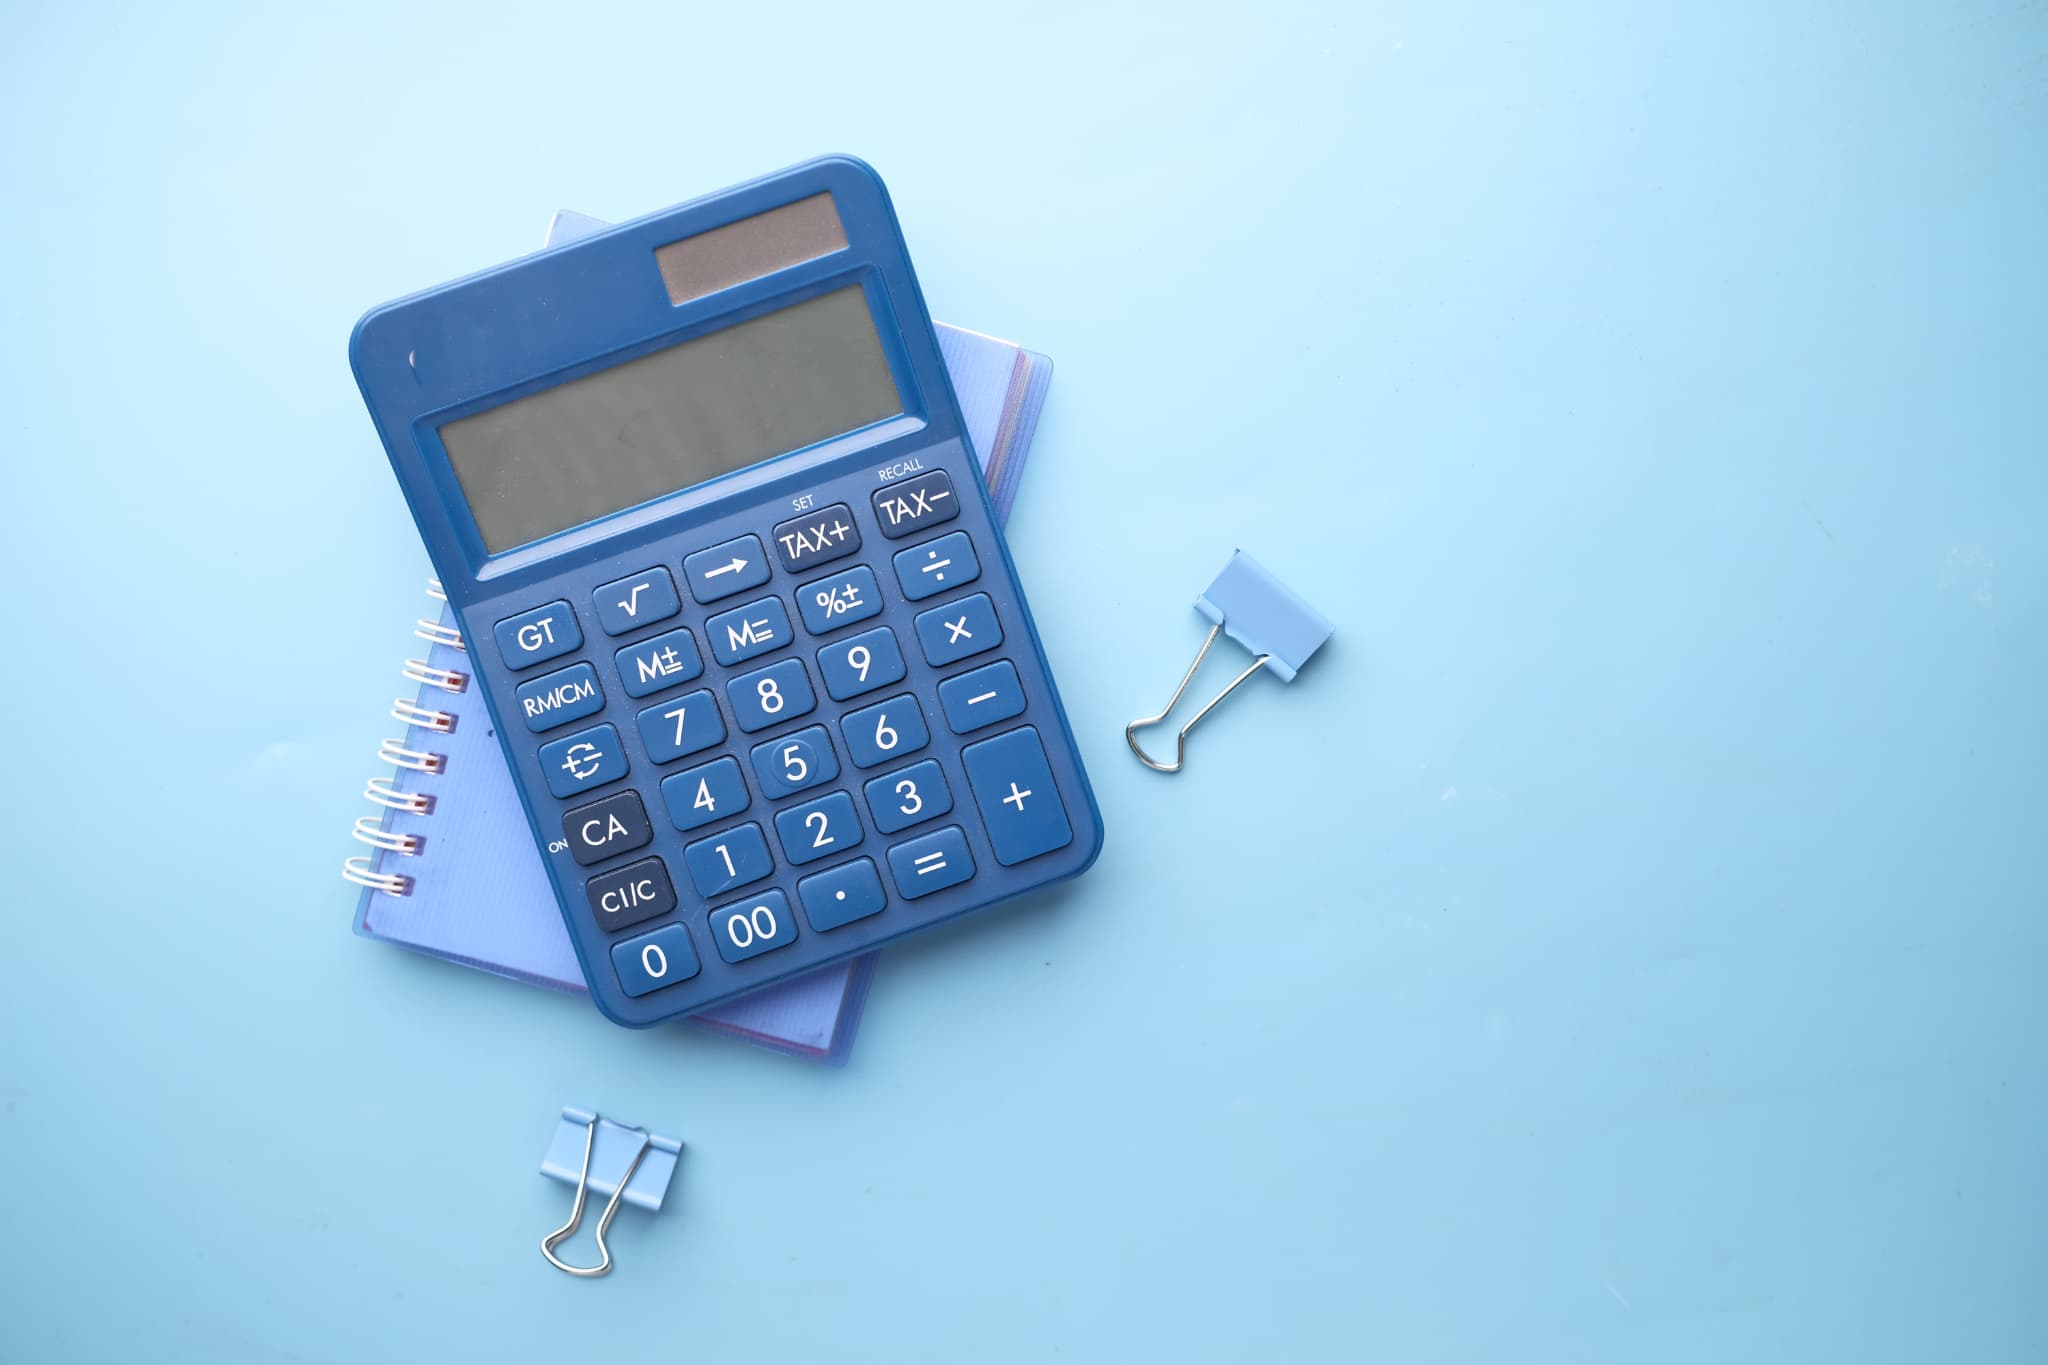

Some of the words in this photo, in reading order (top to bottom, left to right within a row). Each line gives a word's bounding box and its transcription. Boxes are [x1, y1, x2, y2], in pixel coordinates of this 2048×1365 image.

[878, 458, 924, 482] RECALL
[791, 494, 814, 512] SET
[779, 520, 850, 560] TAX+
[517, 617, 553, 651] GT
[847, 646, 871, 682] 9
[523, 679, 595, 718] RM/CM
[757, 678, 784, 714] 8
[664, 708, 686, 746] 7
[875, 714, 898, 750] 6
[783, 745, 808, 781] 5
[693, 777, 715, 812] 4
[895, 780, 922, 815] 3
[1002, 782, 1032, 811] +
[548, 838, 569, 854] ON
[581, 813, 628, 846] CA
[805, 811, 834, 848] 2
[715, 844, 736, 877] 1
[914, 851, 947, 875] =
[727, 906, 777, 948] 00
[641, 944, 668, 978] 0
